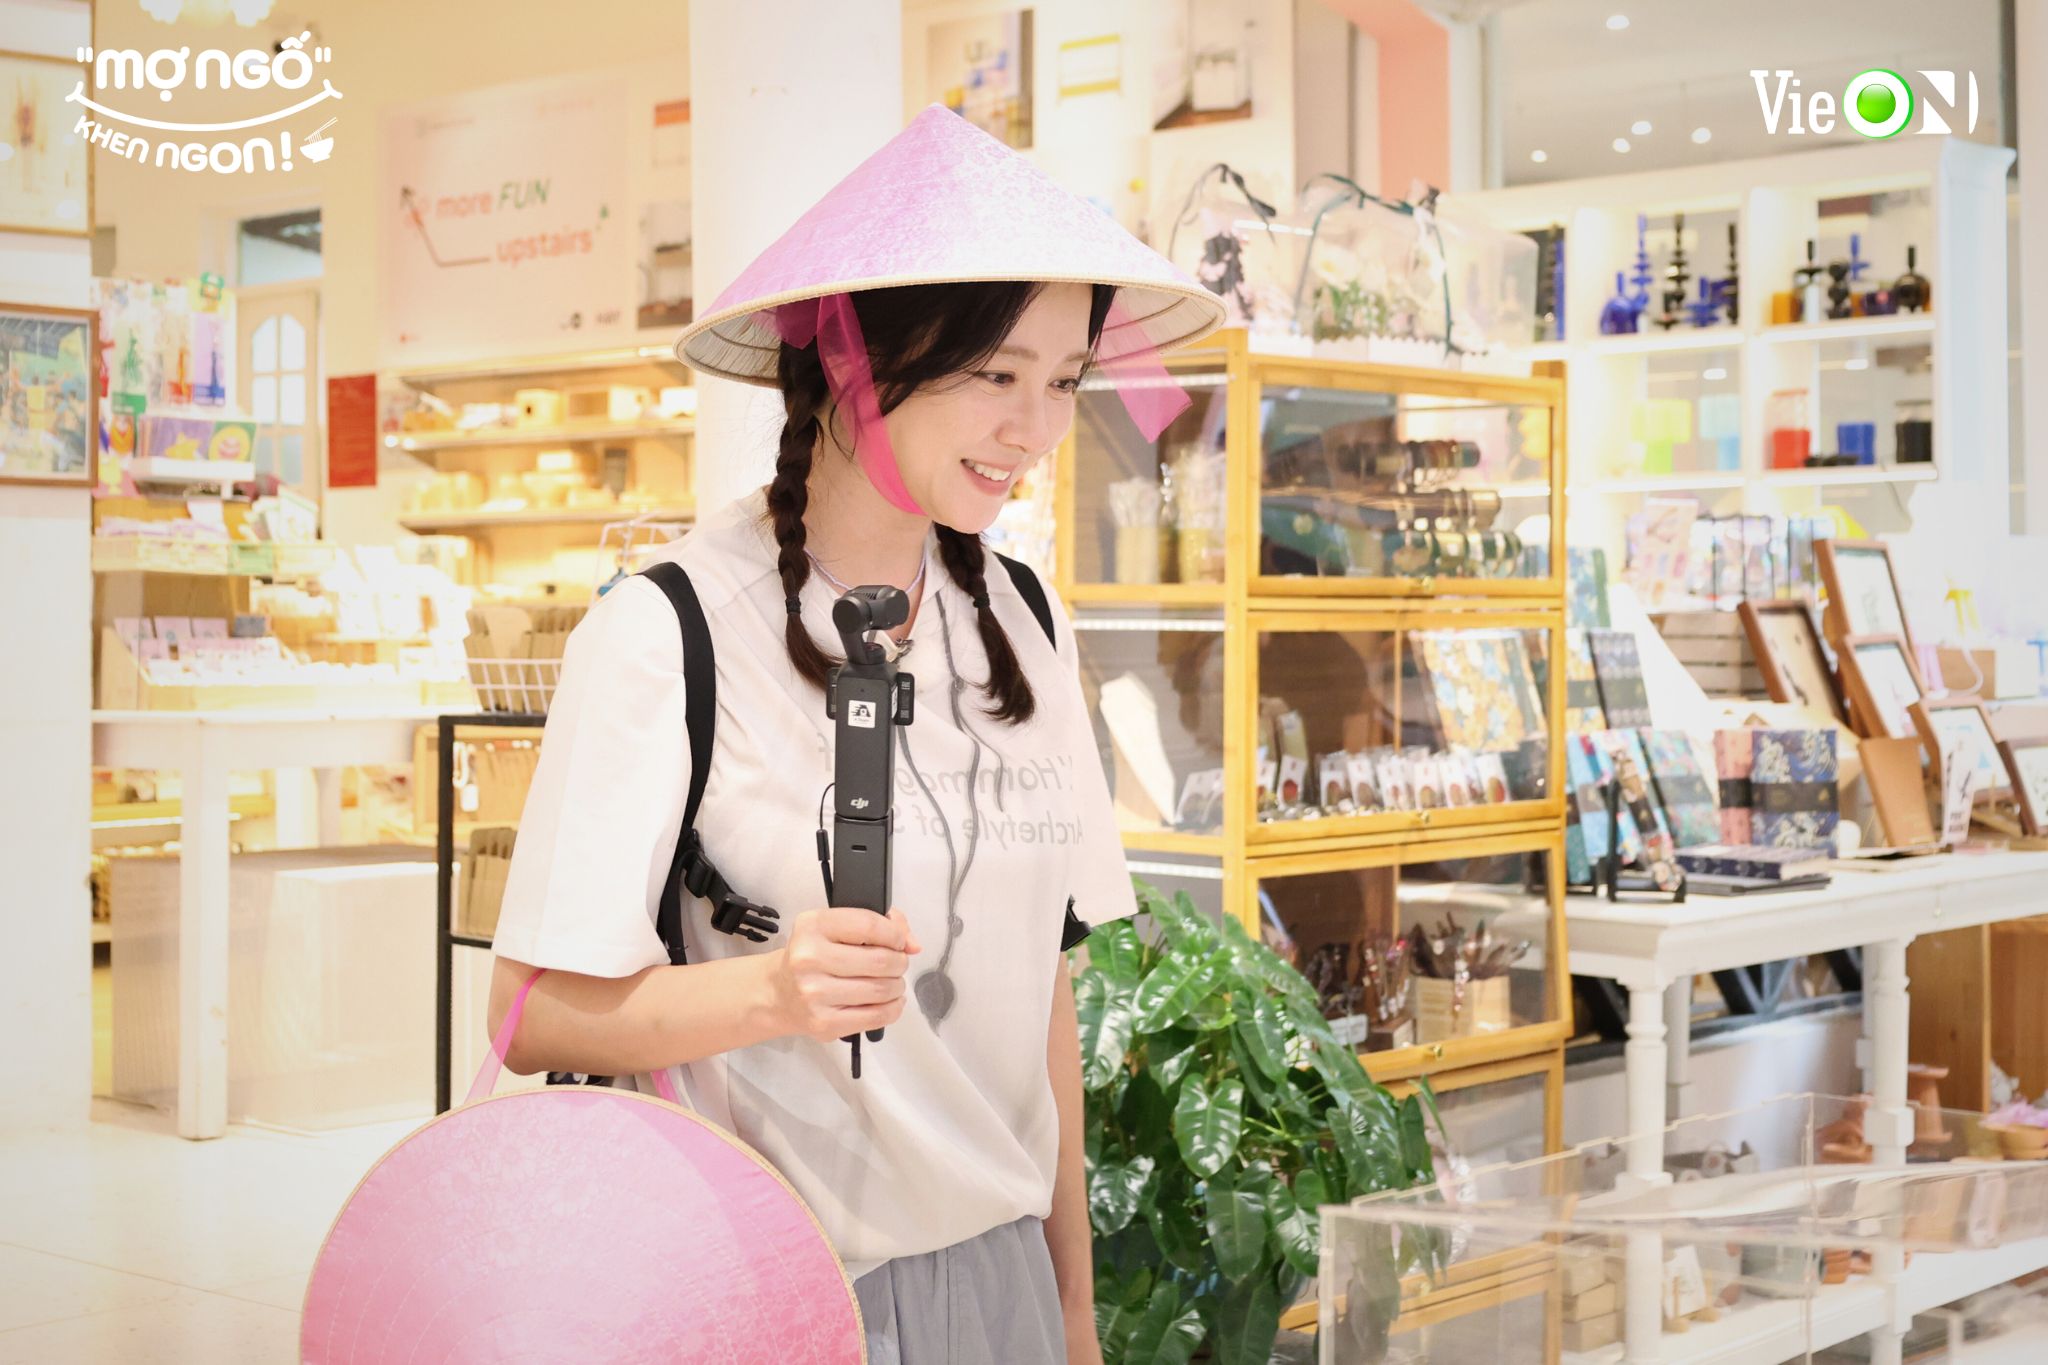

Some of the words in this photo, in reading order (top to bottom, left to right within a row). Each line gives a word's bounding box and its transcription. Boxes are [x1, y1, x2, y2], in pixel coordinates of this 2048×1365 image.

[435, 193, 492, 219] more
[498, 178, 550, 210] FUN
[497, 224, 592, 267] upstairs
